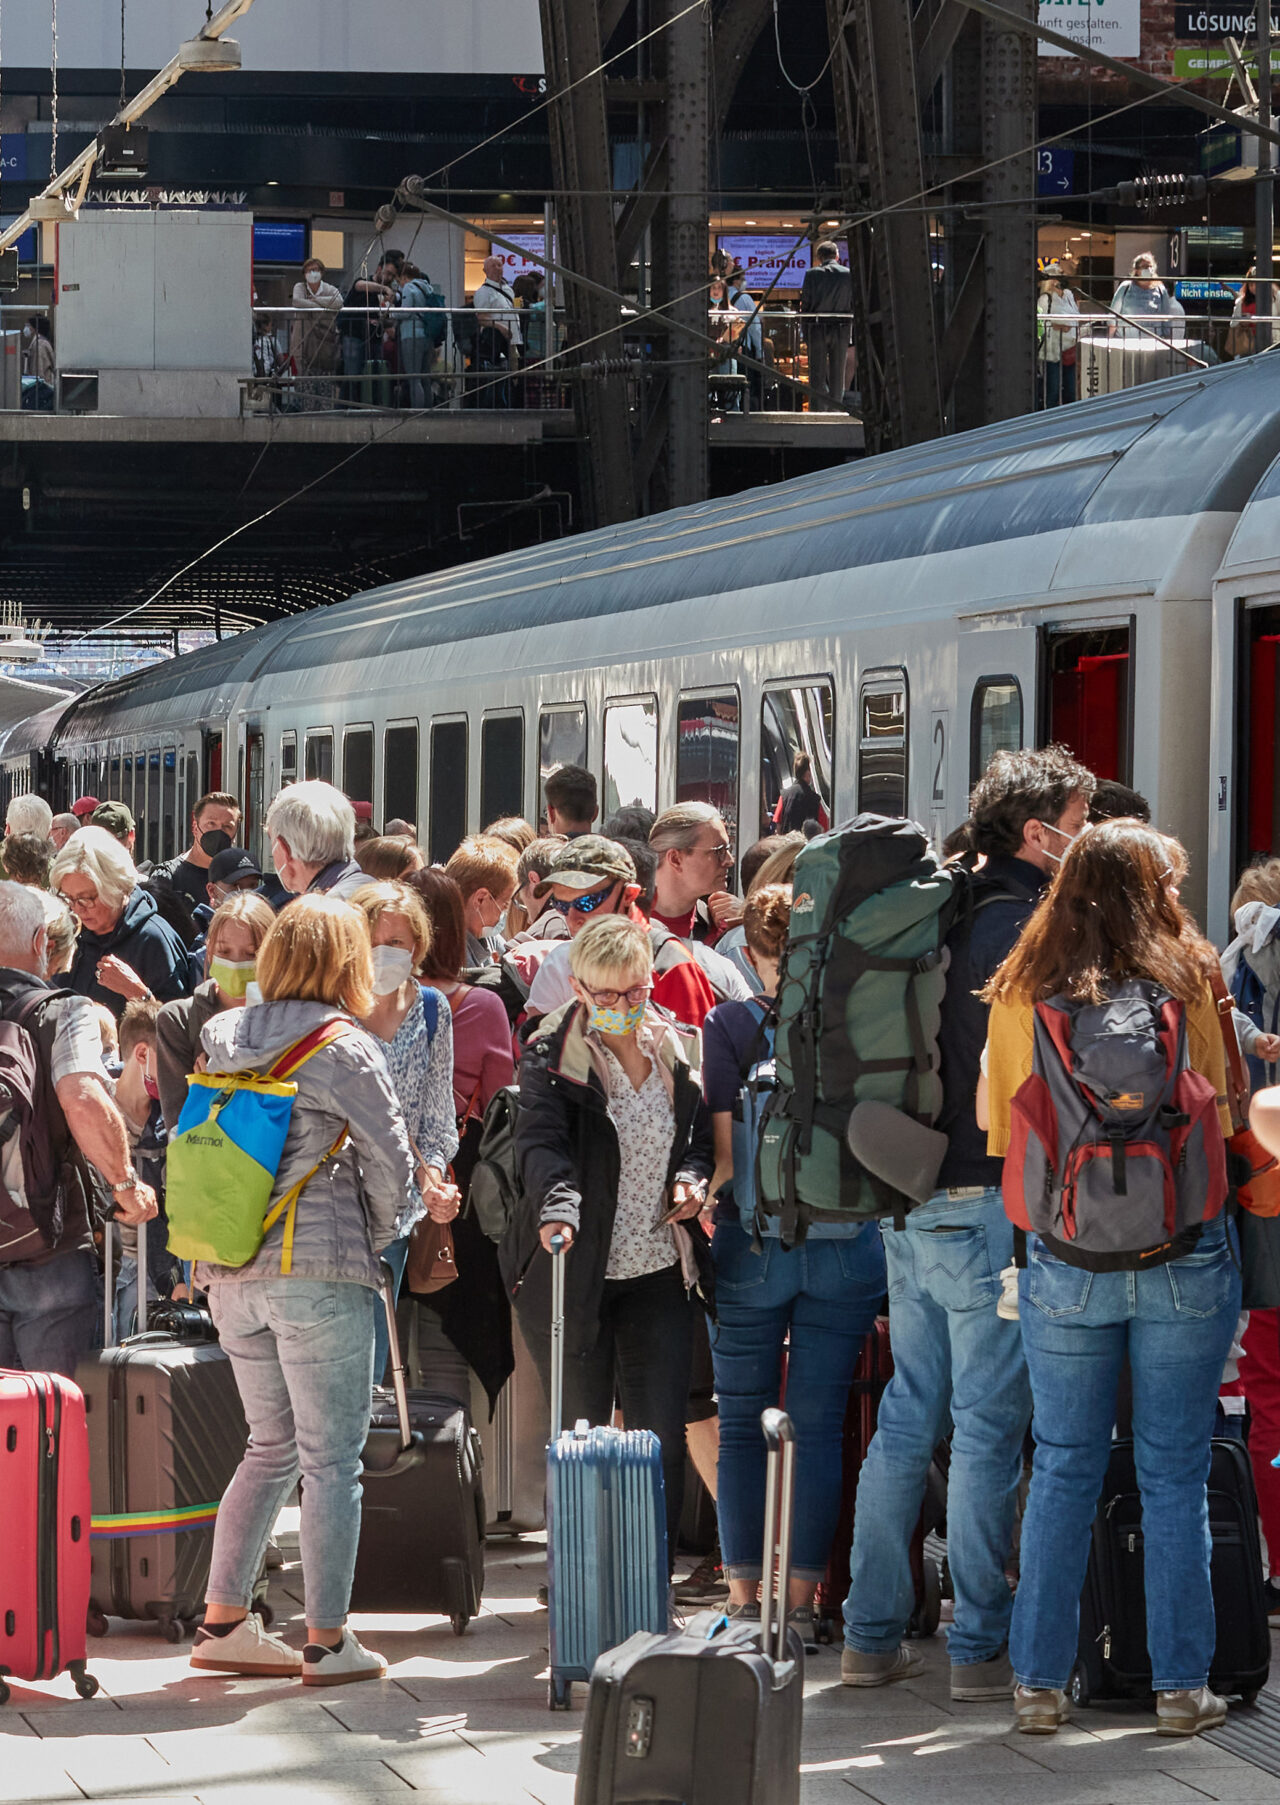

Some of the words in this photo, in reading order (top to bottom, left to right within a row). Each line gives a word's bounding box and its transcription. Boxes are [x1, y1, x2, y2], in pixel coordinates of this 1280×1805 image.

[1066, 18, 1122, 31] gestalten.
[1188, 12, 1279, 32] LÖSUNGN
[0, 157, 18, 168] A-C
[1181, 288, 1201, 297] Nicht
[932, 718, 945, 801] 2
[185, 1134, 224, 1148] Marmot
